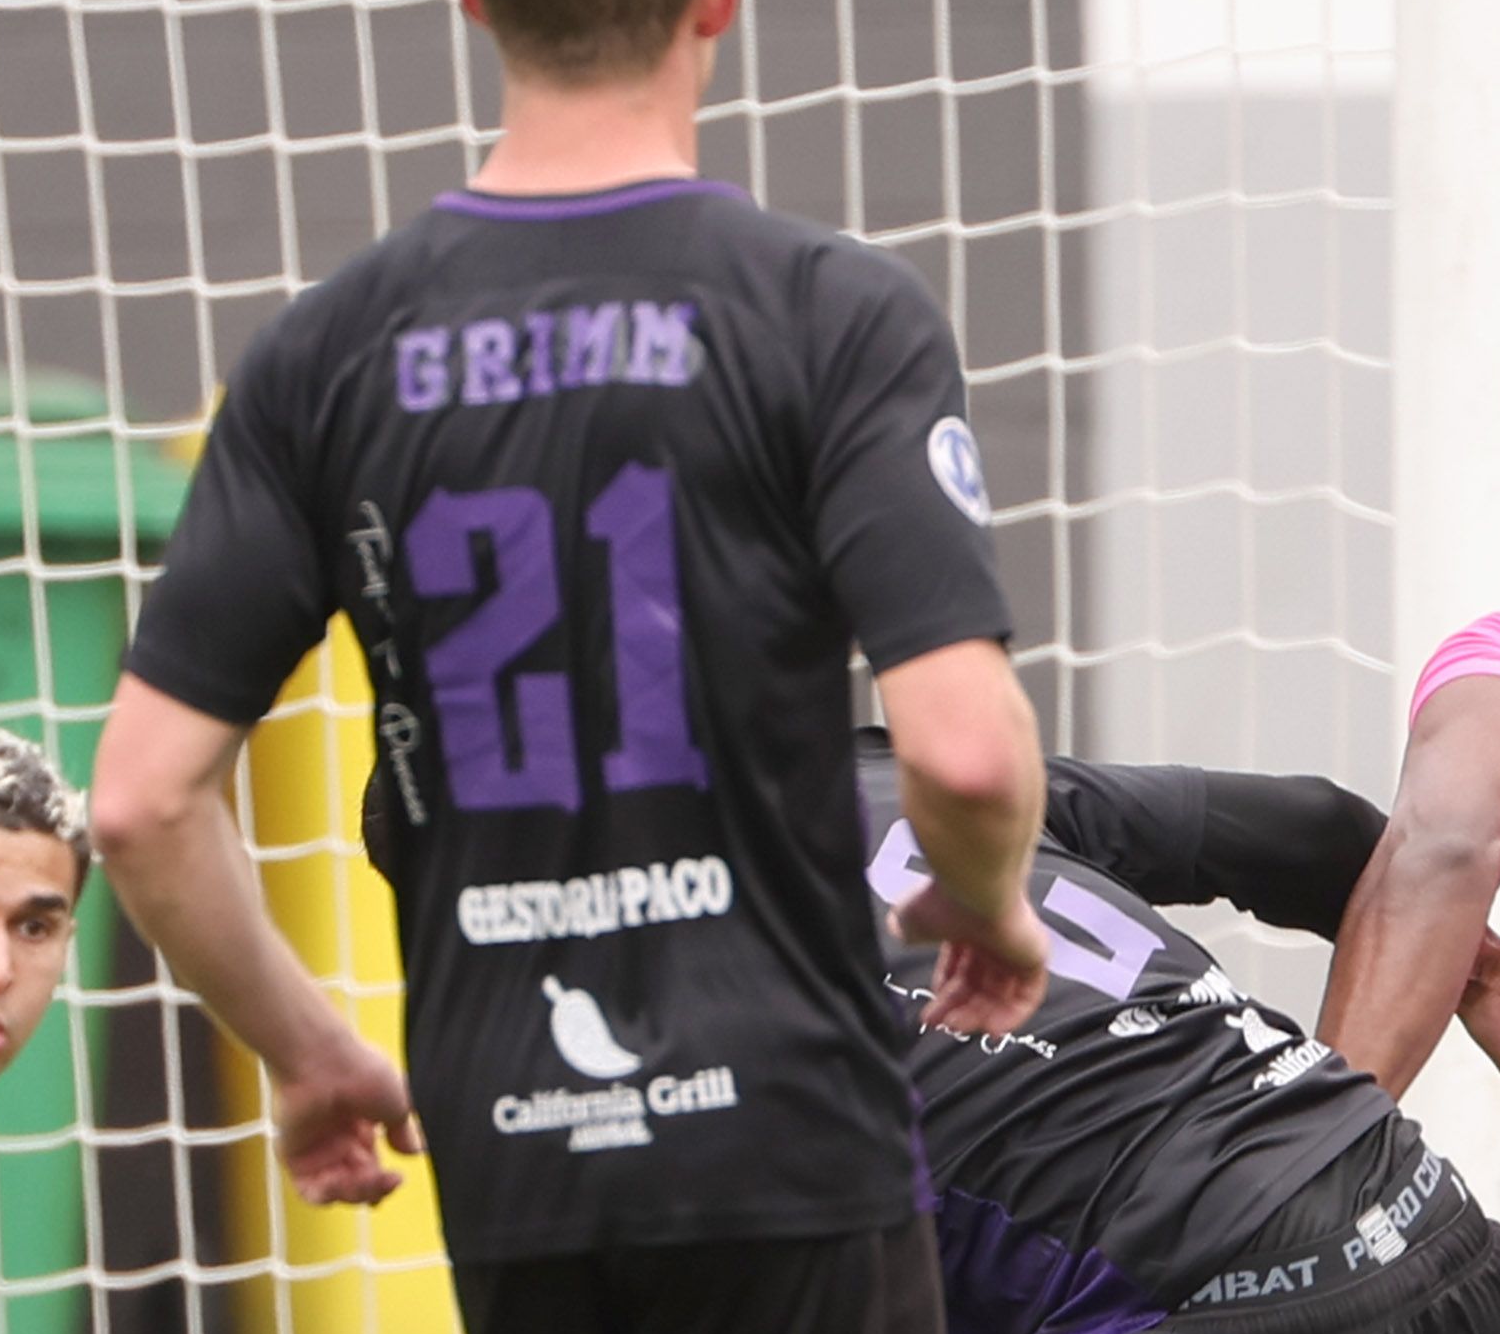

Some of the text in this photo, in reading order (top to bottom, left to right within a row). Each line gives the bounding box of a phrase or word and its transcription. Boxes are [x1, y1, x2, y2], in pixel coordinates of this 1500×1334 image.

[396, 299, 698, 414] GRIMM
[403, 459, 711, 814] 21
[647, 1066, 738, 1116] Grill
